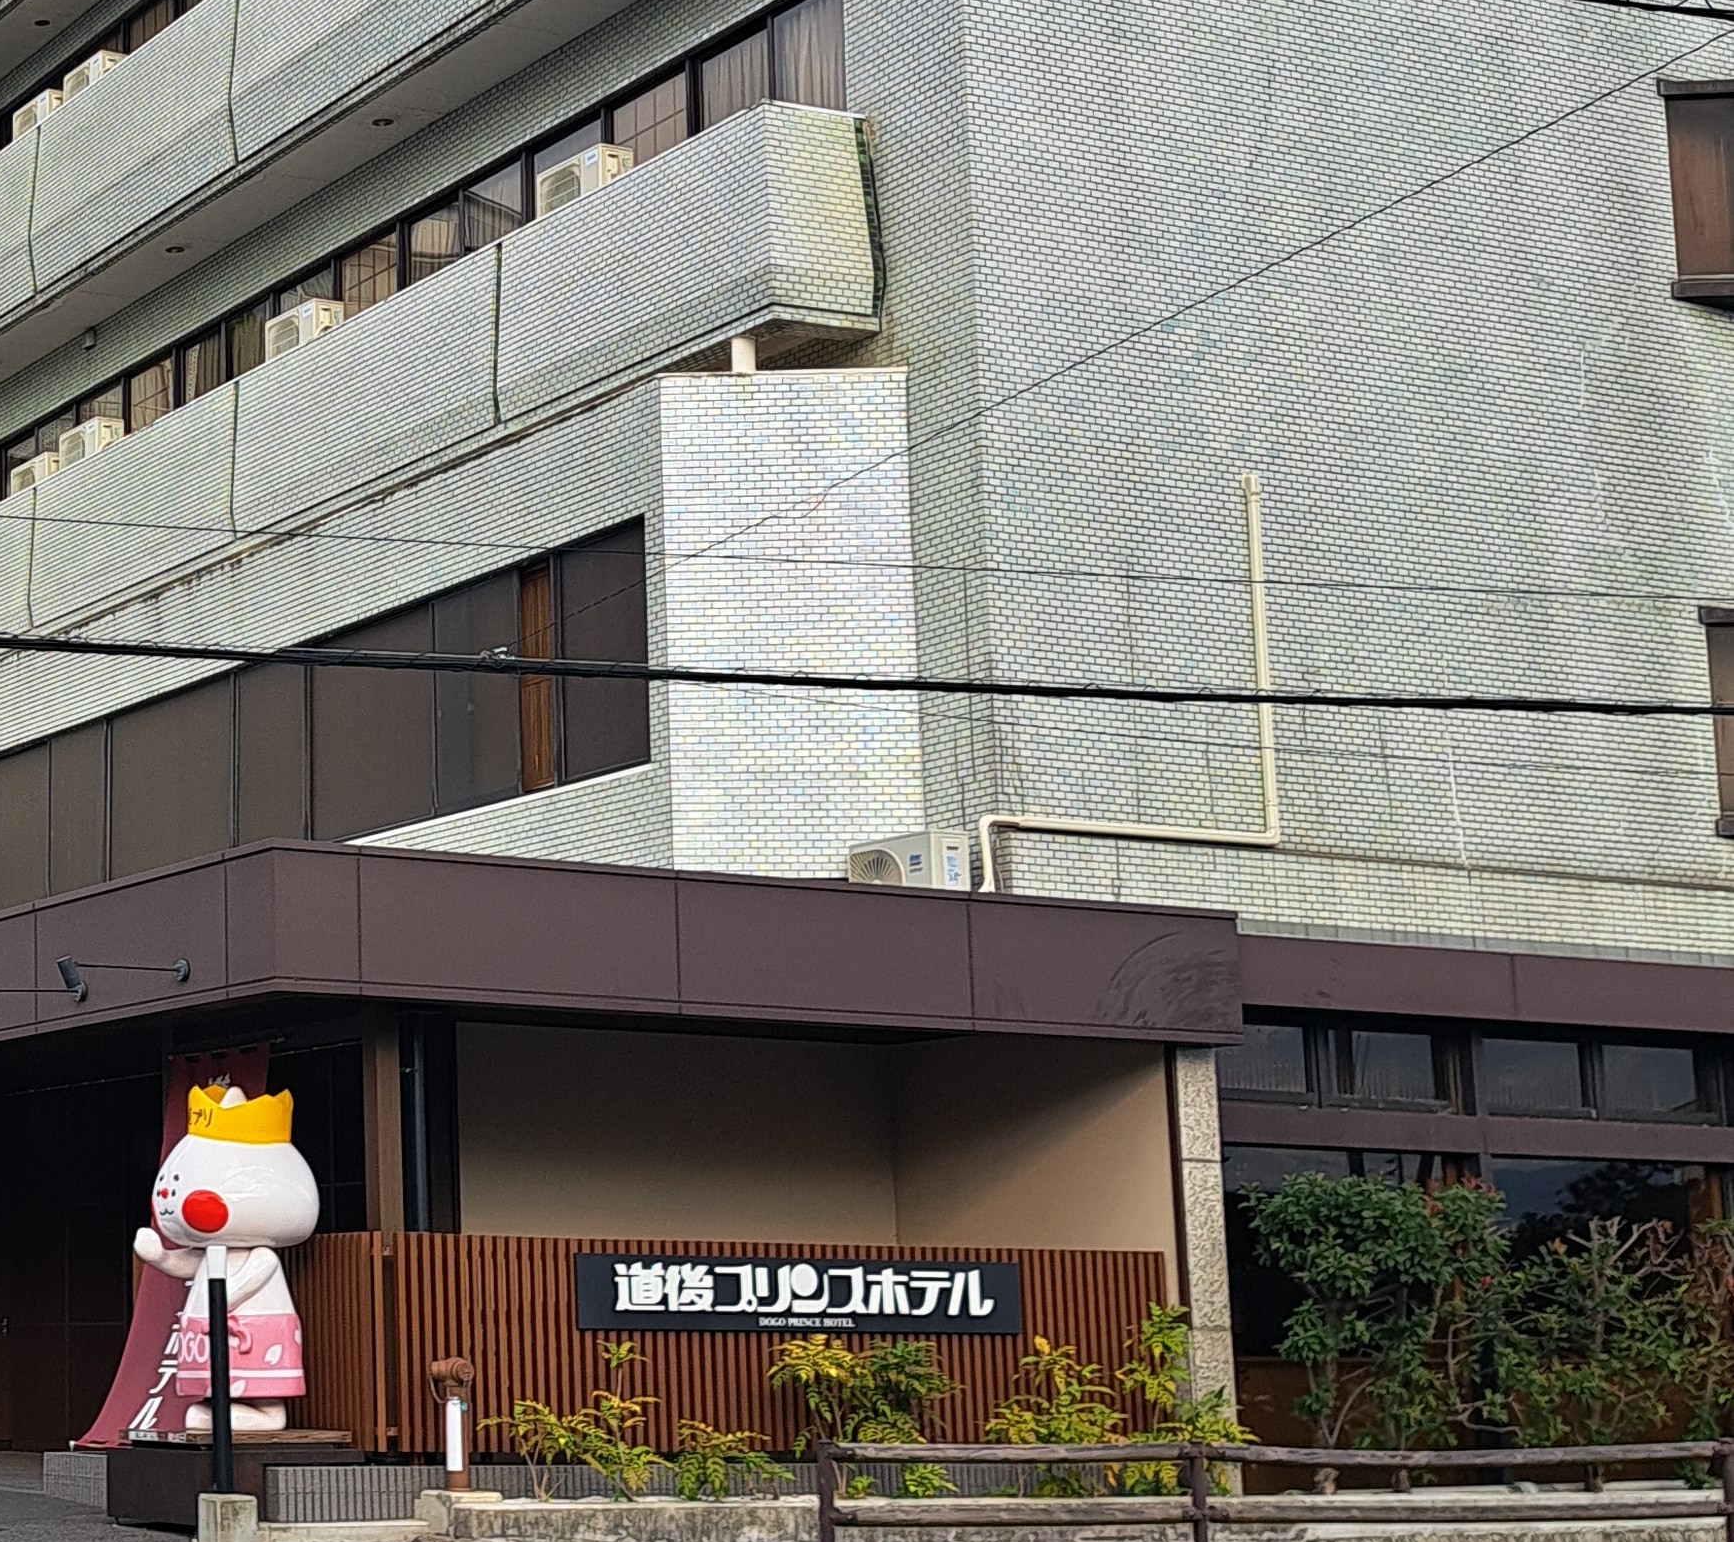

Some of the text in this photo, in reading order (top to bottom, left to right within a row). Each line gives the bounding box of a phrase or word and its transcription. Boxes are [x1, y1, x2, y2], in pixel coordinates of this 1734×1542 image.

[614, 1261, 996, 1317] 道後プリンスホテル
